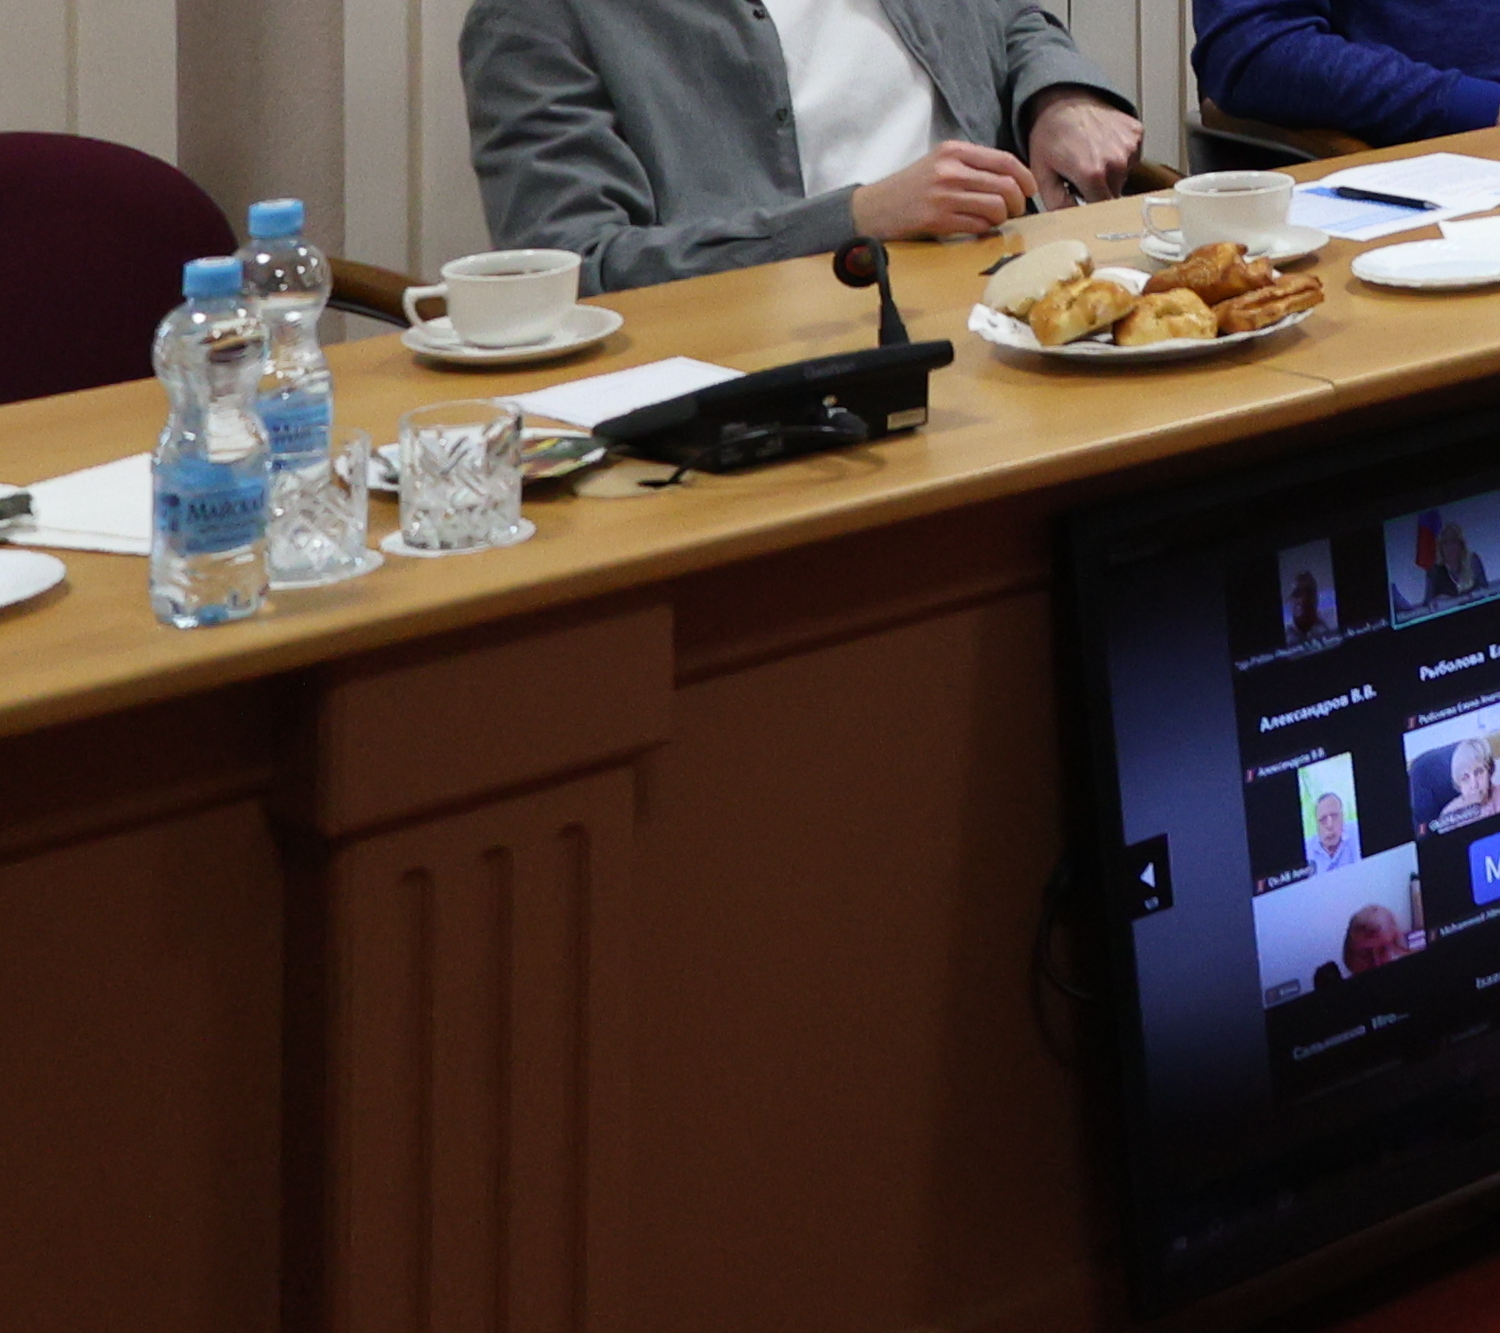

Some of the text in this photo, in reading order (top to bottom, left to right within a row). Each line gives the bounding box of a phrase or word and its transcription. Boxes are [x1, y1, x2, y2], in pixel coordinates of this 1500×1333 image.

[1417, 650, 1485, 682] Рыболова
[1258, 682, 1378, 733] Александров В.В.
